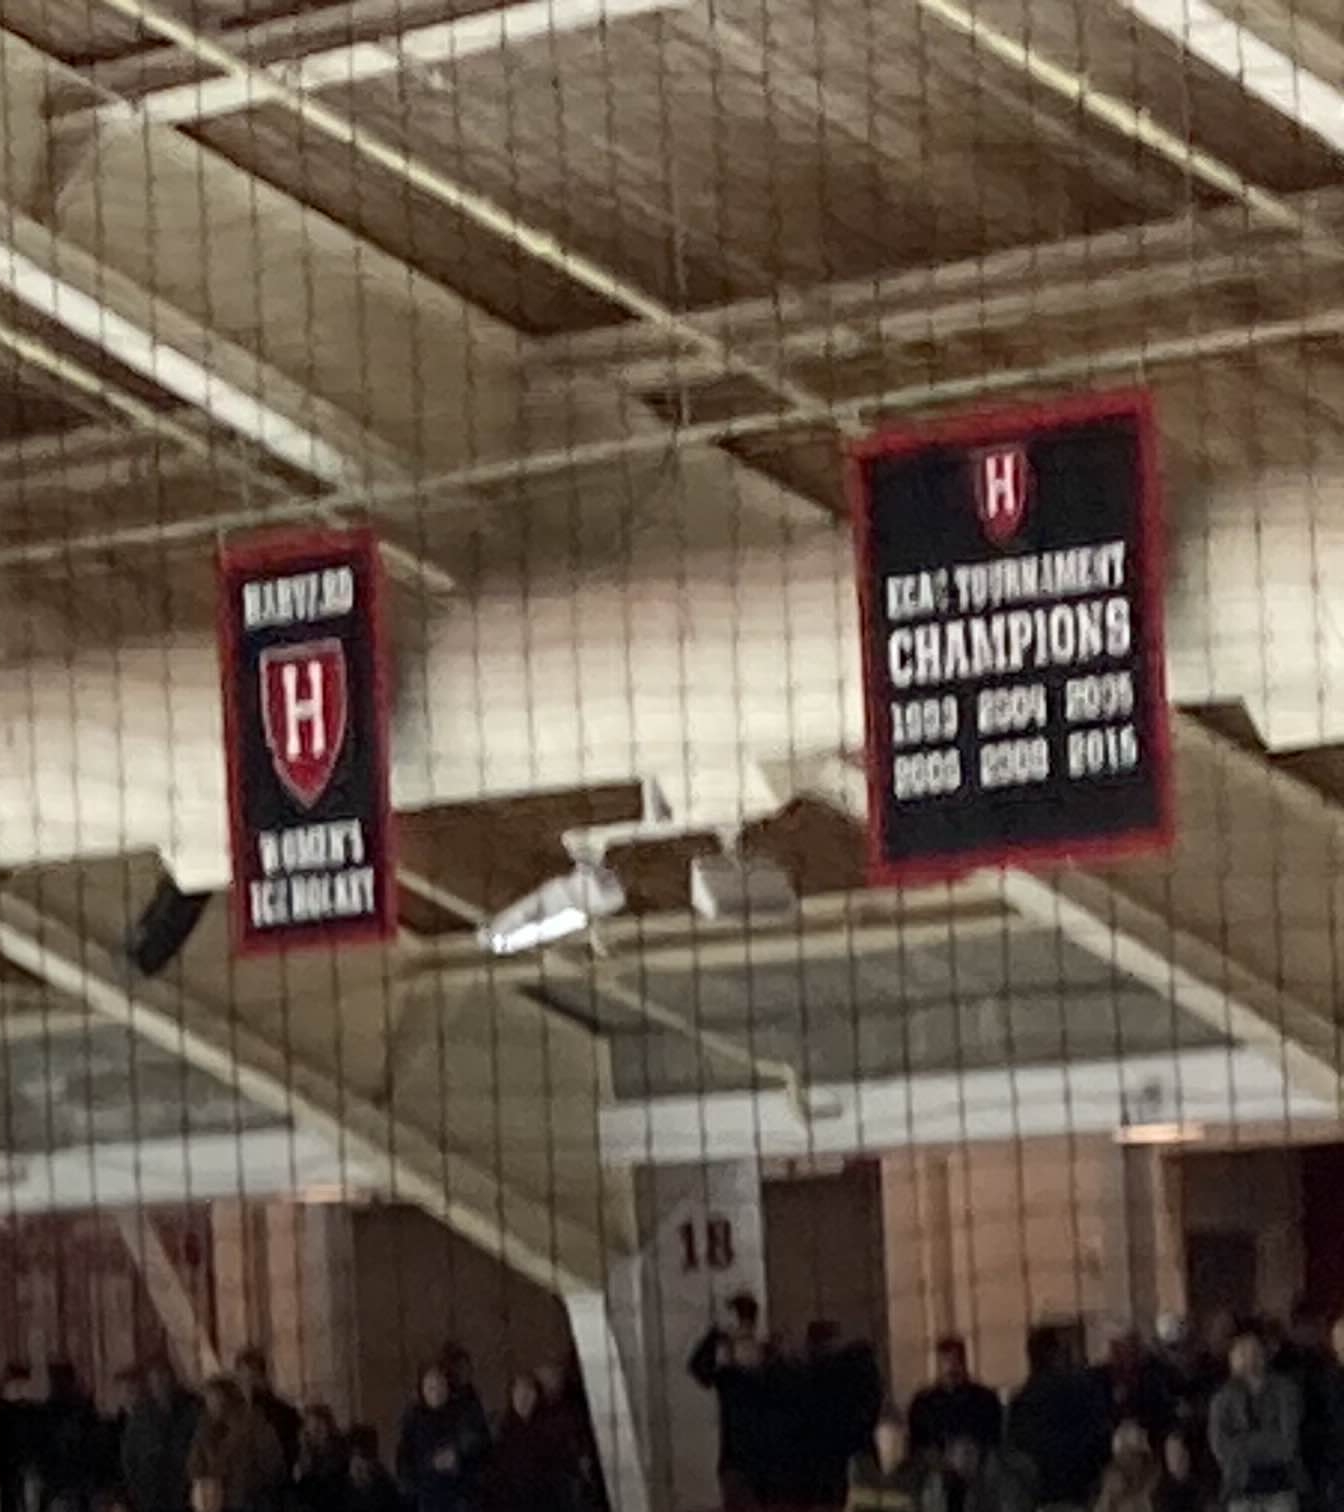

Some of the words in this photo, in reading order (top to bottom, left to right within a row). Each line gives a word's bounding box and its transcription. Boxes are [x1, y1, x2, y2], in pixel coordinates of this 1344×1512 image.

[984, 450, 1015, 520] H
[243, 564, 355, 631] HARVARD
[955, 540, 1126, 613] TOURNAMENT
[887, 596, 1131, 689] CHAMPIONS
[281, 659, 327, 762] H
[676, 1219, 736, 1272] 18
